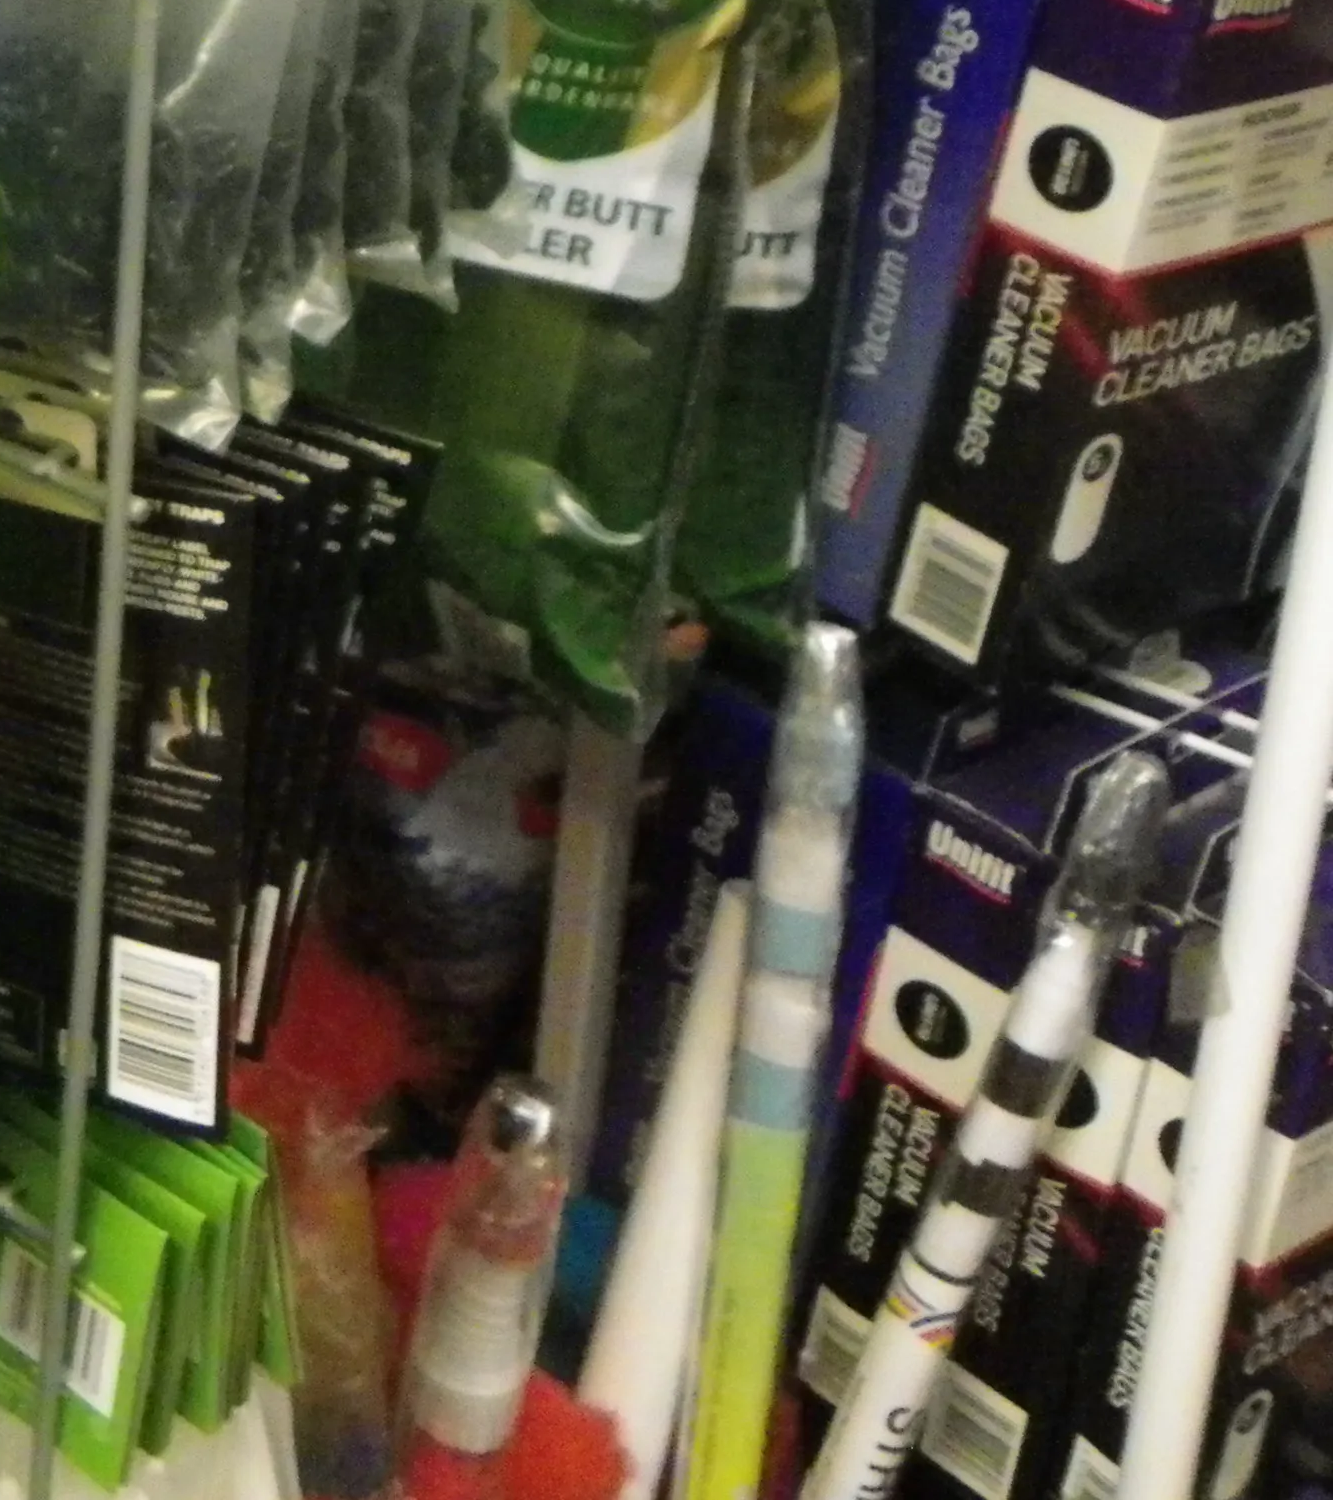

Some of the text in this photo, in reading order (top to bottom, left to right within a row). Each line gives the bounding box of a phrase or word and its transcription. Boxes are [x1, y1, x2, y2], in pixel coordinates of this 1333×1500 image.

[563, 188, 673, 237] BUTT
[845, 3, 981, 381] Vacuum Cleaner Bags
[954, 250, 1041, 469] CLEANER BAGS
[1012, 270, 1074, 392] VACUUM
[1092, 314, 1319, 410] CLEANER BAGS
[1109, 301, 1239, 365] VACUUM
[169, 501, 226, 526] TRAPS
[927, 819, 1017, 897] Unifit
[1019, 1176, 1067, 1279] VACUUM
